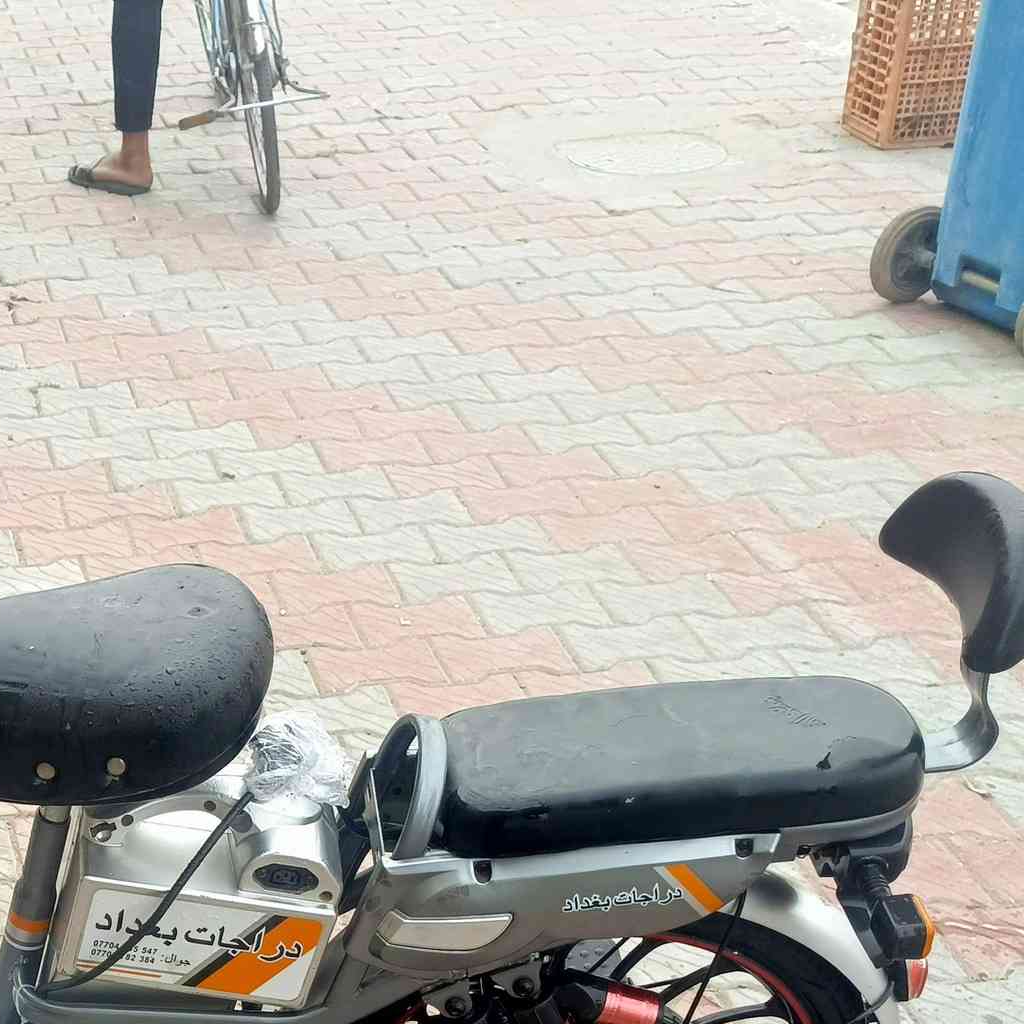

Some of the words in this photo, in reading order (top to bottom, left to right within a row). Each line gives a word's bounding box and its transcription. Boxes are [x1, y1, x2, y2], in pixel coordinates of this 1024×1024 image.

[562, 893, 612, 912] بغداد
[613, 882, 683, 906] دراجات
[183, 926, 304, 963] دراجات
